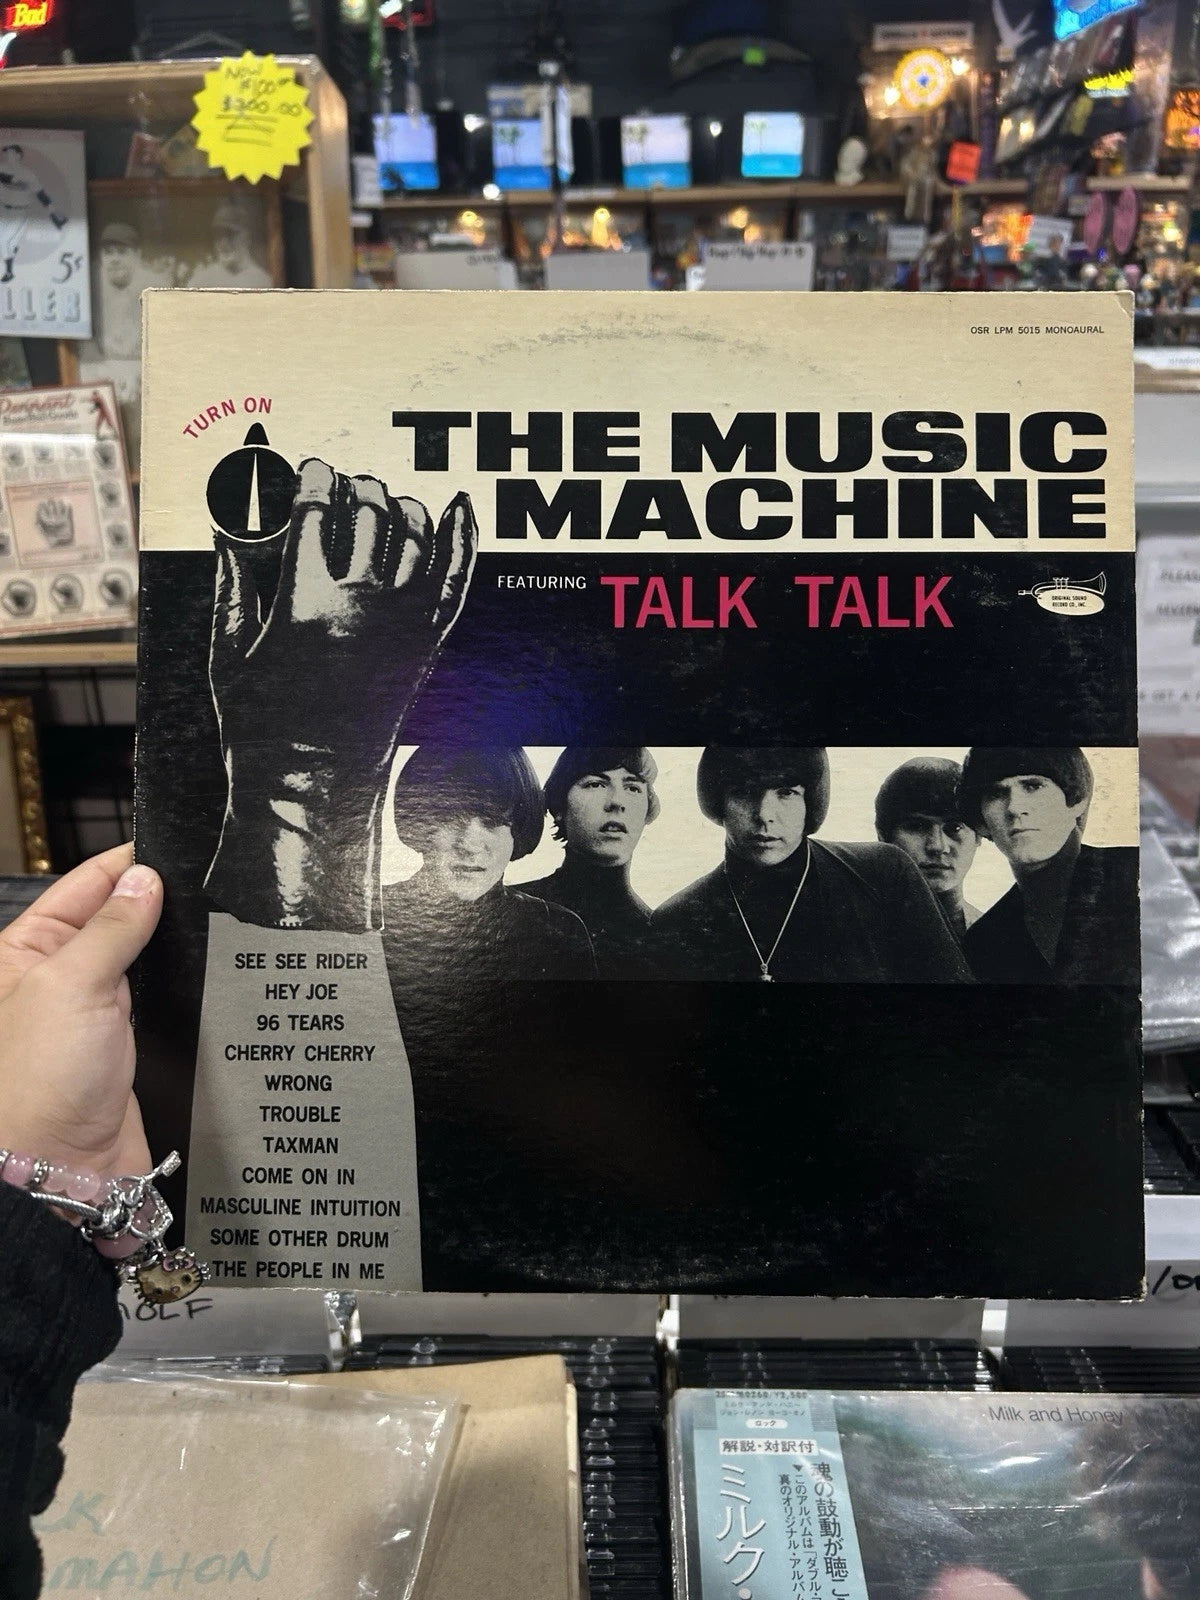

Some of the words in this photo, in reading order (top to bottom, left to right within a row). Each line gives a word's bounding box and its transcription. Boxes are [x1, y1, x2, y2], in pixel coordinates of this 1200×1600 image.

[971, 326, 990, 335] OSR
[994, 326, 1013, 335] LPM
[1018, 326, 1041, 335] 5015
[1045, 325, 1105, 335] MONOAURAL
[182, 399, 236, 439] TURN
[244, 397, 272, 414] ON
[392, 411, 640, 472] THE
[671, 411, 1108, 473] MUSIC
[496, 478, 1107, 540] MACHINE
[497, 575, 587, 590] FEATURING
[600, 576, 758, 629] TALK
[794, 575, 955, 629] TALK
[235, 953, 266, 970] SEE
[275, 953, 307, 970] SEE
[316, 953, 368, 970] RIDER
[265, 984, 299, 1000] HEY
[305, 984, 338, 1000] JOE
[256, 1014, 280, 1031] 96
[288, 1015, 345, 1031] TEARS
[224, 1045, 295, 1062] CHERRY
[304, 1045, 375, 1062] CHERRY
[265, 1075, 332, 1092] WRONG
[259, 1106, 341, 1123] TROUBLE
[262, 1136, 338, 1154] TAXMAN
[242, 1167, 293, 1185] COME
[301, 1168, 328, 1185] ON
[337, 1168, 355, 1185] IN
[200, 1197, 302, 1216] MASCULINE
[310, 1199, 401, 1217] INTUITION
[210, 1228, 260, 1246] SOME
[268, 1230, 328, 1247] OTHER
[337, 1231, 389, 1248] DRUM
[212, 1260, 247, 1278] THE
[256, 1261, 323, 1279] PEOPLE
[332, 1262, 350, 1279] IN
[359, 1263, 385, 1280] ME
[988, 1405, 1025, 1422] Milk
[1028, 1407, 1063, 1422] and
[1066, 1406, 1124, 1426] Honey
[722, 1440, 815, 1454] 解説・対訳付
